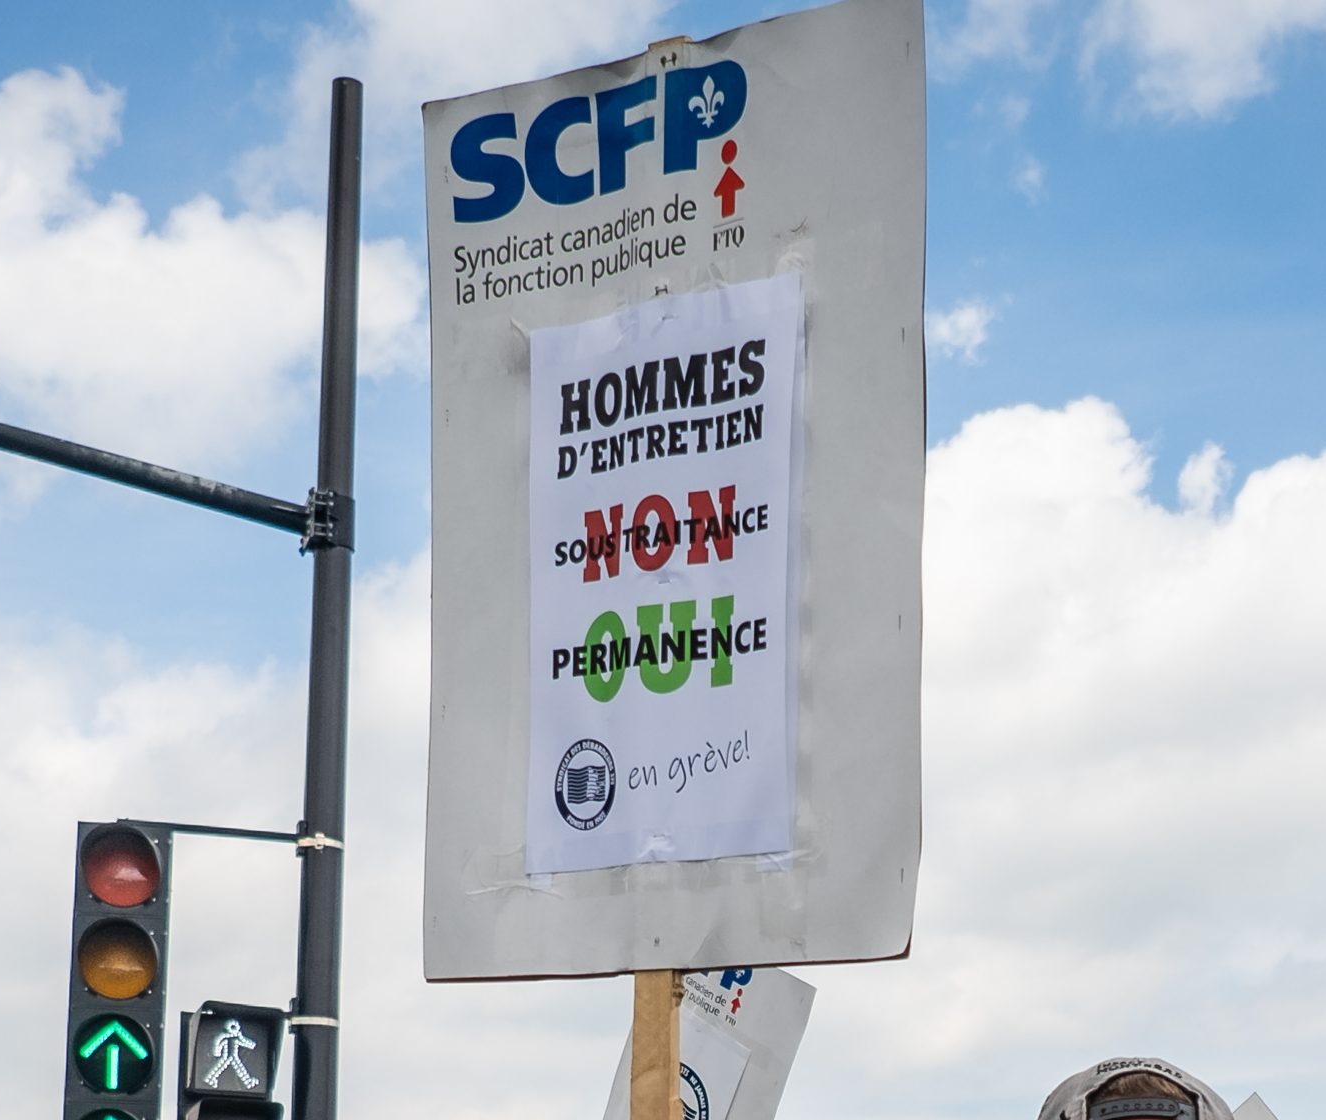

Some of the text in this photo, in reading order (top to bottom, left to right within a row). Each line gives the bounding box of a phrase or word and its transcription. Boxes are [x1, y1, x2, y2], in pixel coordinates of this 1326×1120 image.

[450, 59, 748, 223] SCFP
[454, 193, 698, 275] Syndicat canadien de
[712, 224, 746, 252] FTQ
[456, 235, 688, 305] la fonction publique
[559, 339, 767, 435] HOMMES
[557, 404, 765, 480] D'ENTRETIEN
[554, 504, 769, 567] SOUS TRAITANCE
[583, 484, 736, 583] NON
[552, 617, 768, 680] PERMANENCE
[583, 594, 734, 703] OUI
[628, 729, 751, 794] en grève!
[686, 976, 714, 1000] canadien
[715, 994, 727, 1007] de
[689, 992, 720, 1017] publique
